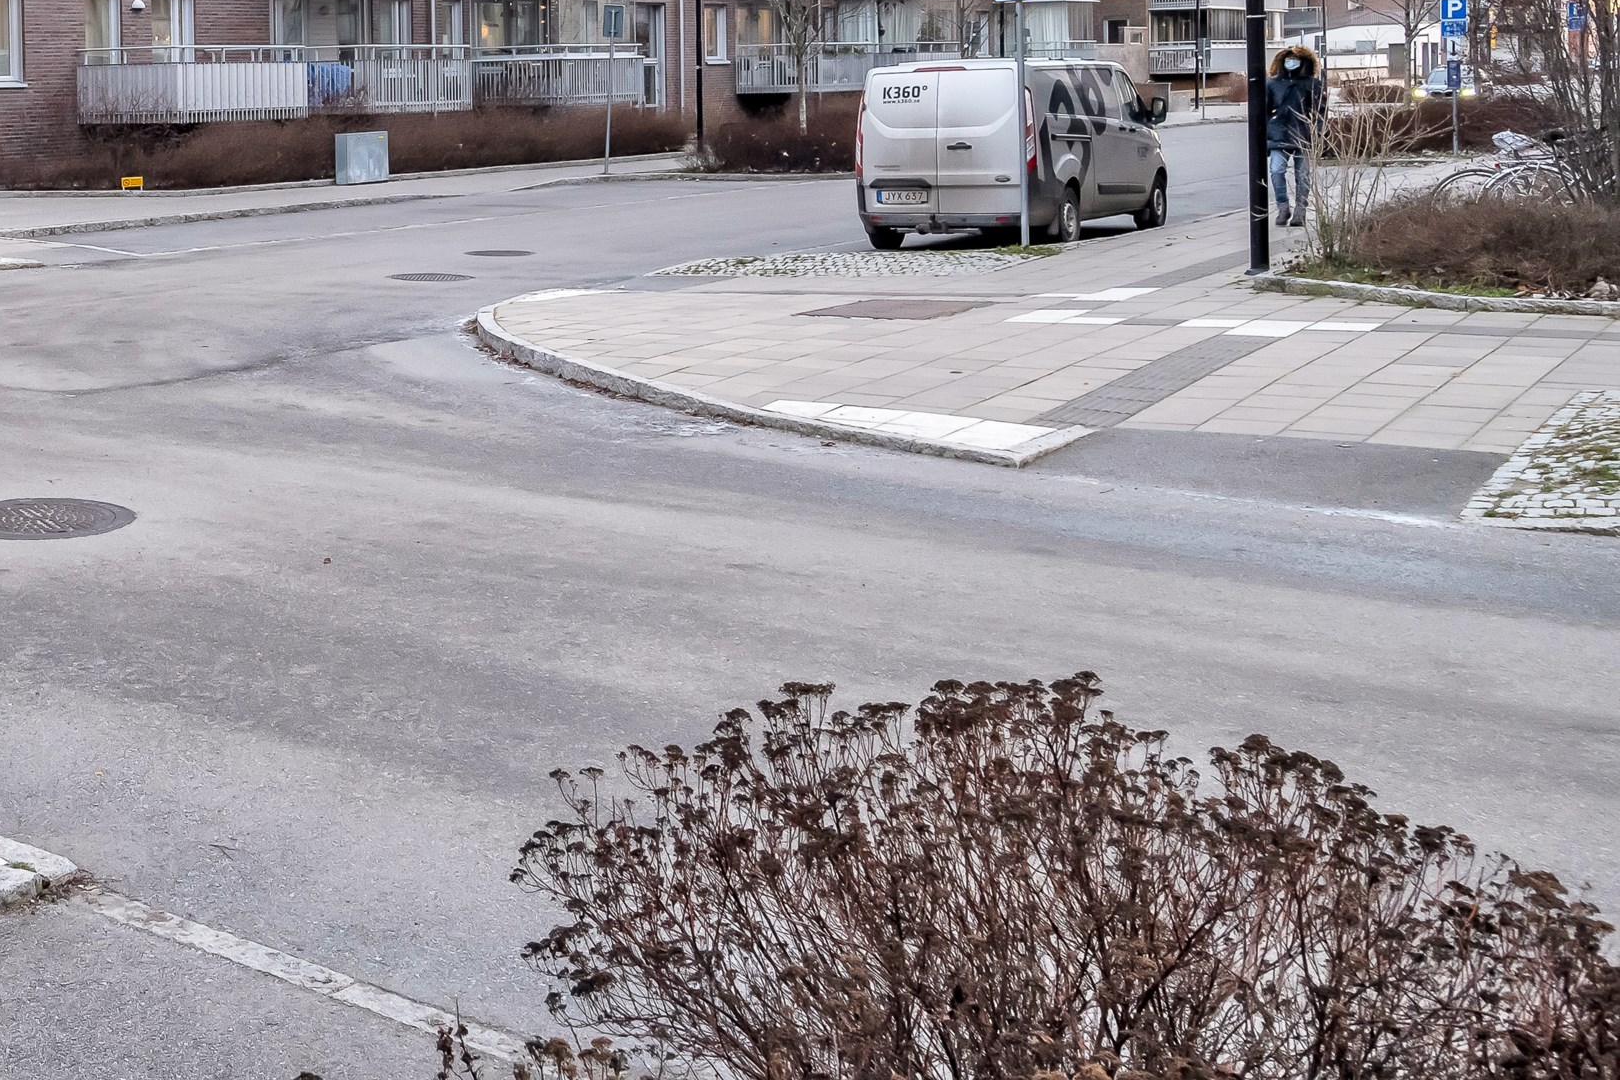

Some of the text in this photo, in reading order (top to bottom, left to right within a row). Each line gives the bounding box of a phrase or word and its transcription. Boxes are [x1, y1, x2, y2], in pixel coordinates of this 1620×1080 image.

[1448, 0, 1462, 18] P
[885, 190, 923, 200] JYX 637
